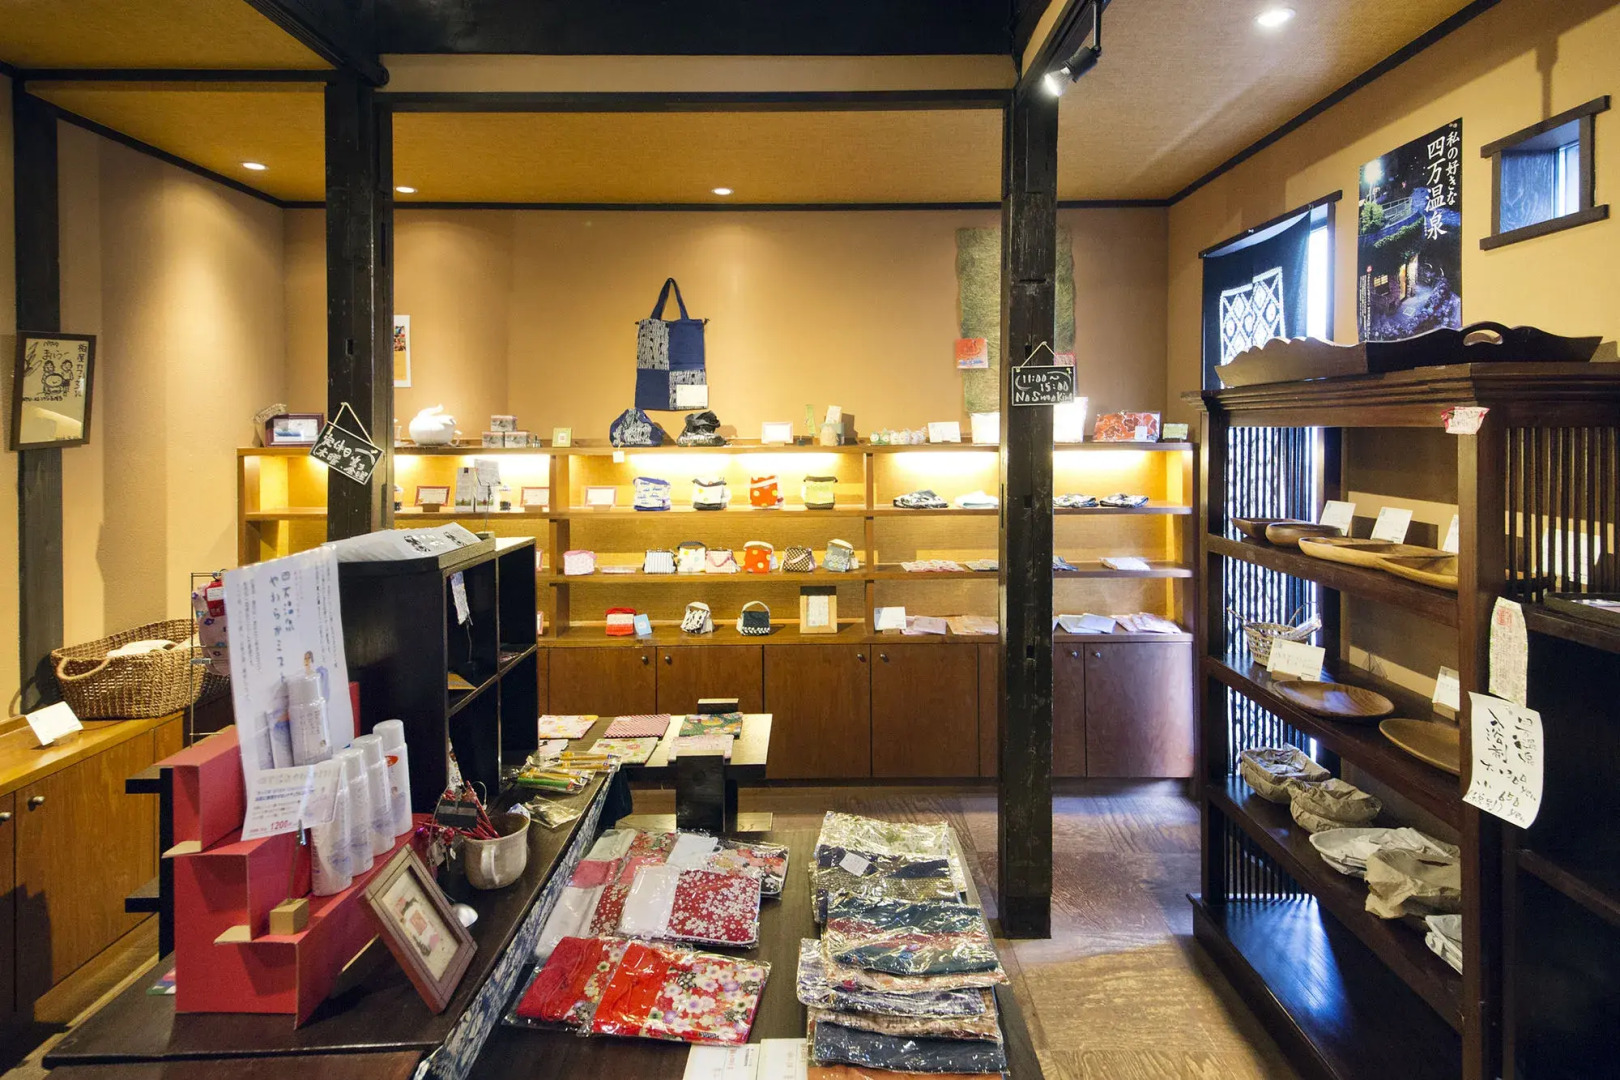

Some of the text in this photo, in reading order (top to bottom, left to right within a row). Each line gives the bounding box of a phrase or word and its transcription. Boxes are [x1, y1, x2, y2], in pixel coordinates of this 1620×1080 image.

[1424, 135, 1448, 240] 四万温泉
[1445, 131, 1460, 206] 私の好きな
[1040, 381, 1069, 392] 15:00
